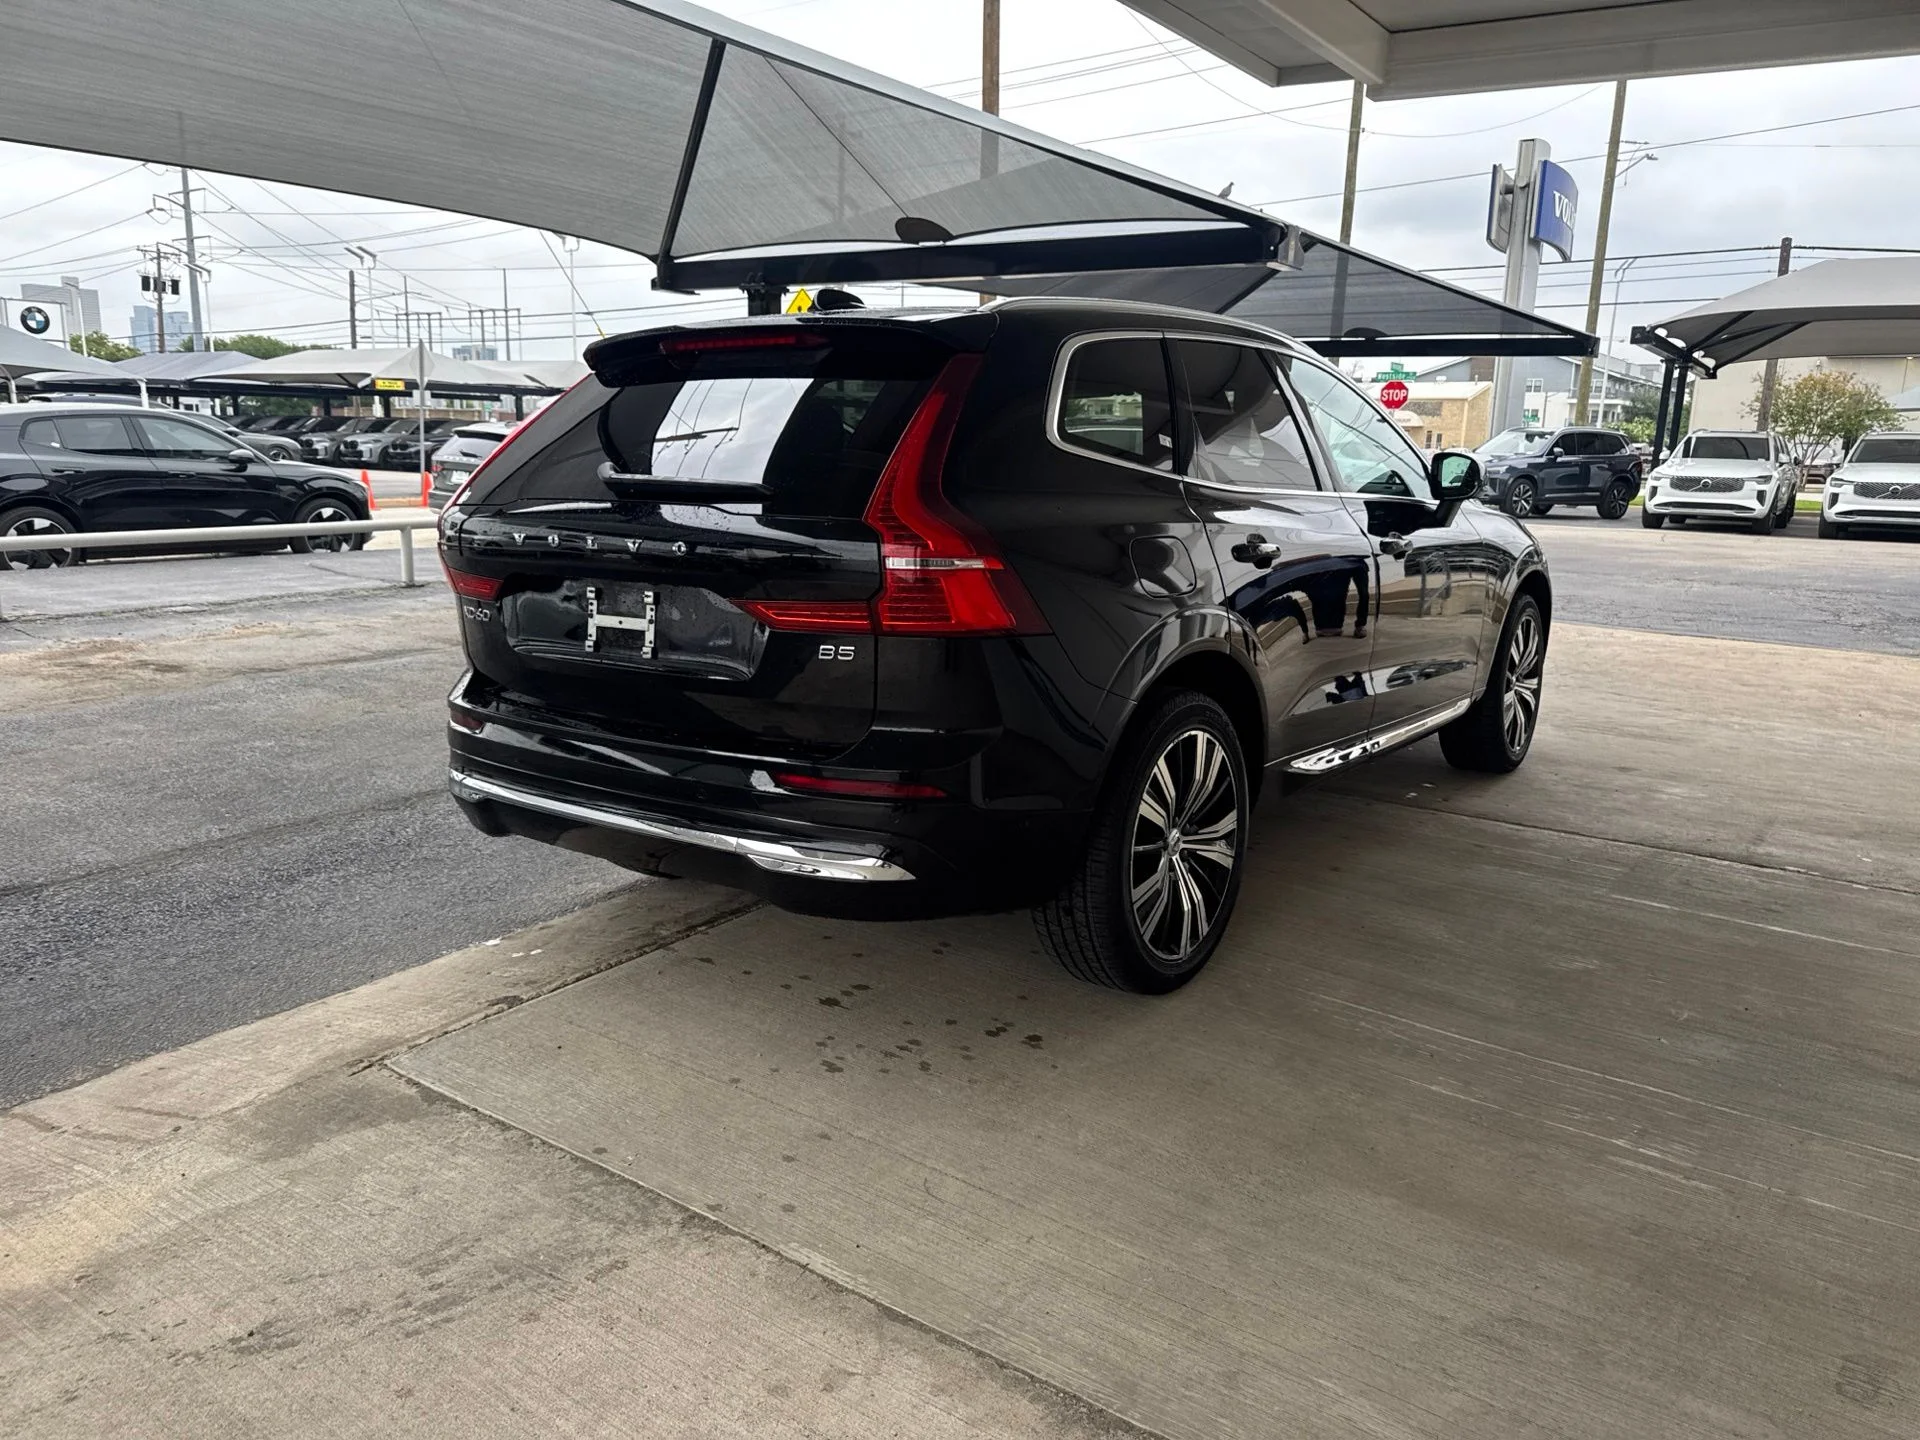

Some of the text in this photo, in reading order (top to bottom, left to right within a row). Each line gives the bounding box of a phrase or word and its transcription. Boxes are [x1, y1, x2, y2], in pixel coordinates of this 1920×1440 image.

[1381, 389, 1407, 401] STOP
[512, 532, 687, 556] VOLVO
[818, 644, 855, 660] B5
